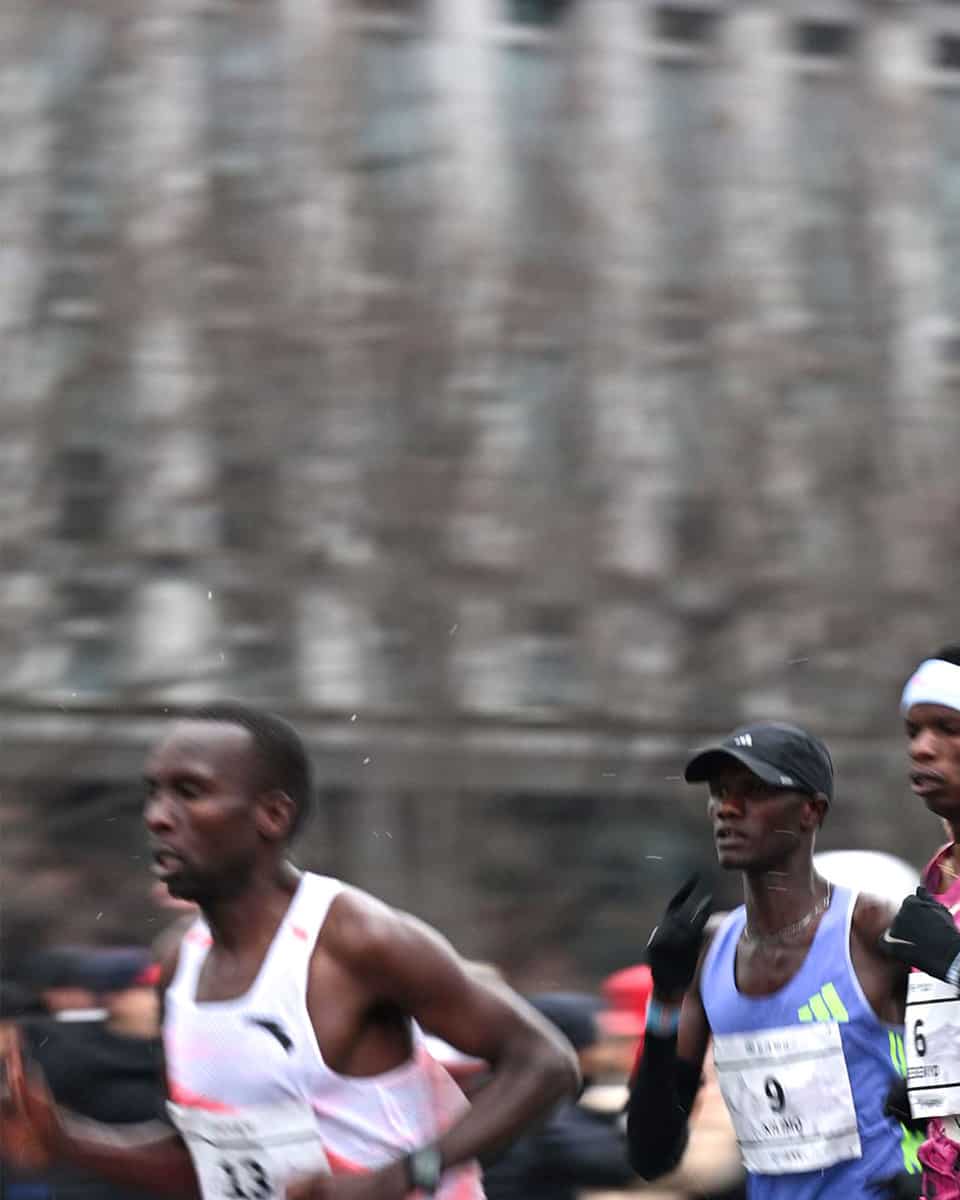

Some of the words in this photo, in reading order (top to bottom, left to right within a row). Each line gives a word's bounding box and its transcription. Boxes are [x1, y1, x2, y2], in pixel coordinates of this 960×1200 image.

[914, 1019, 926, 1057] 6
[765, 1076, 785, 1113] 9
[220, 1158, 272, 1200] 13
